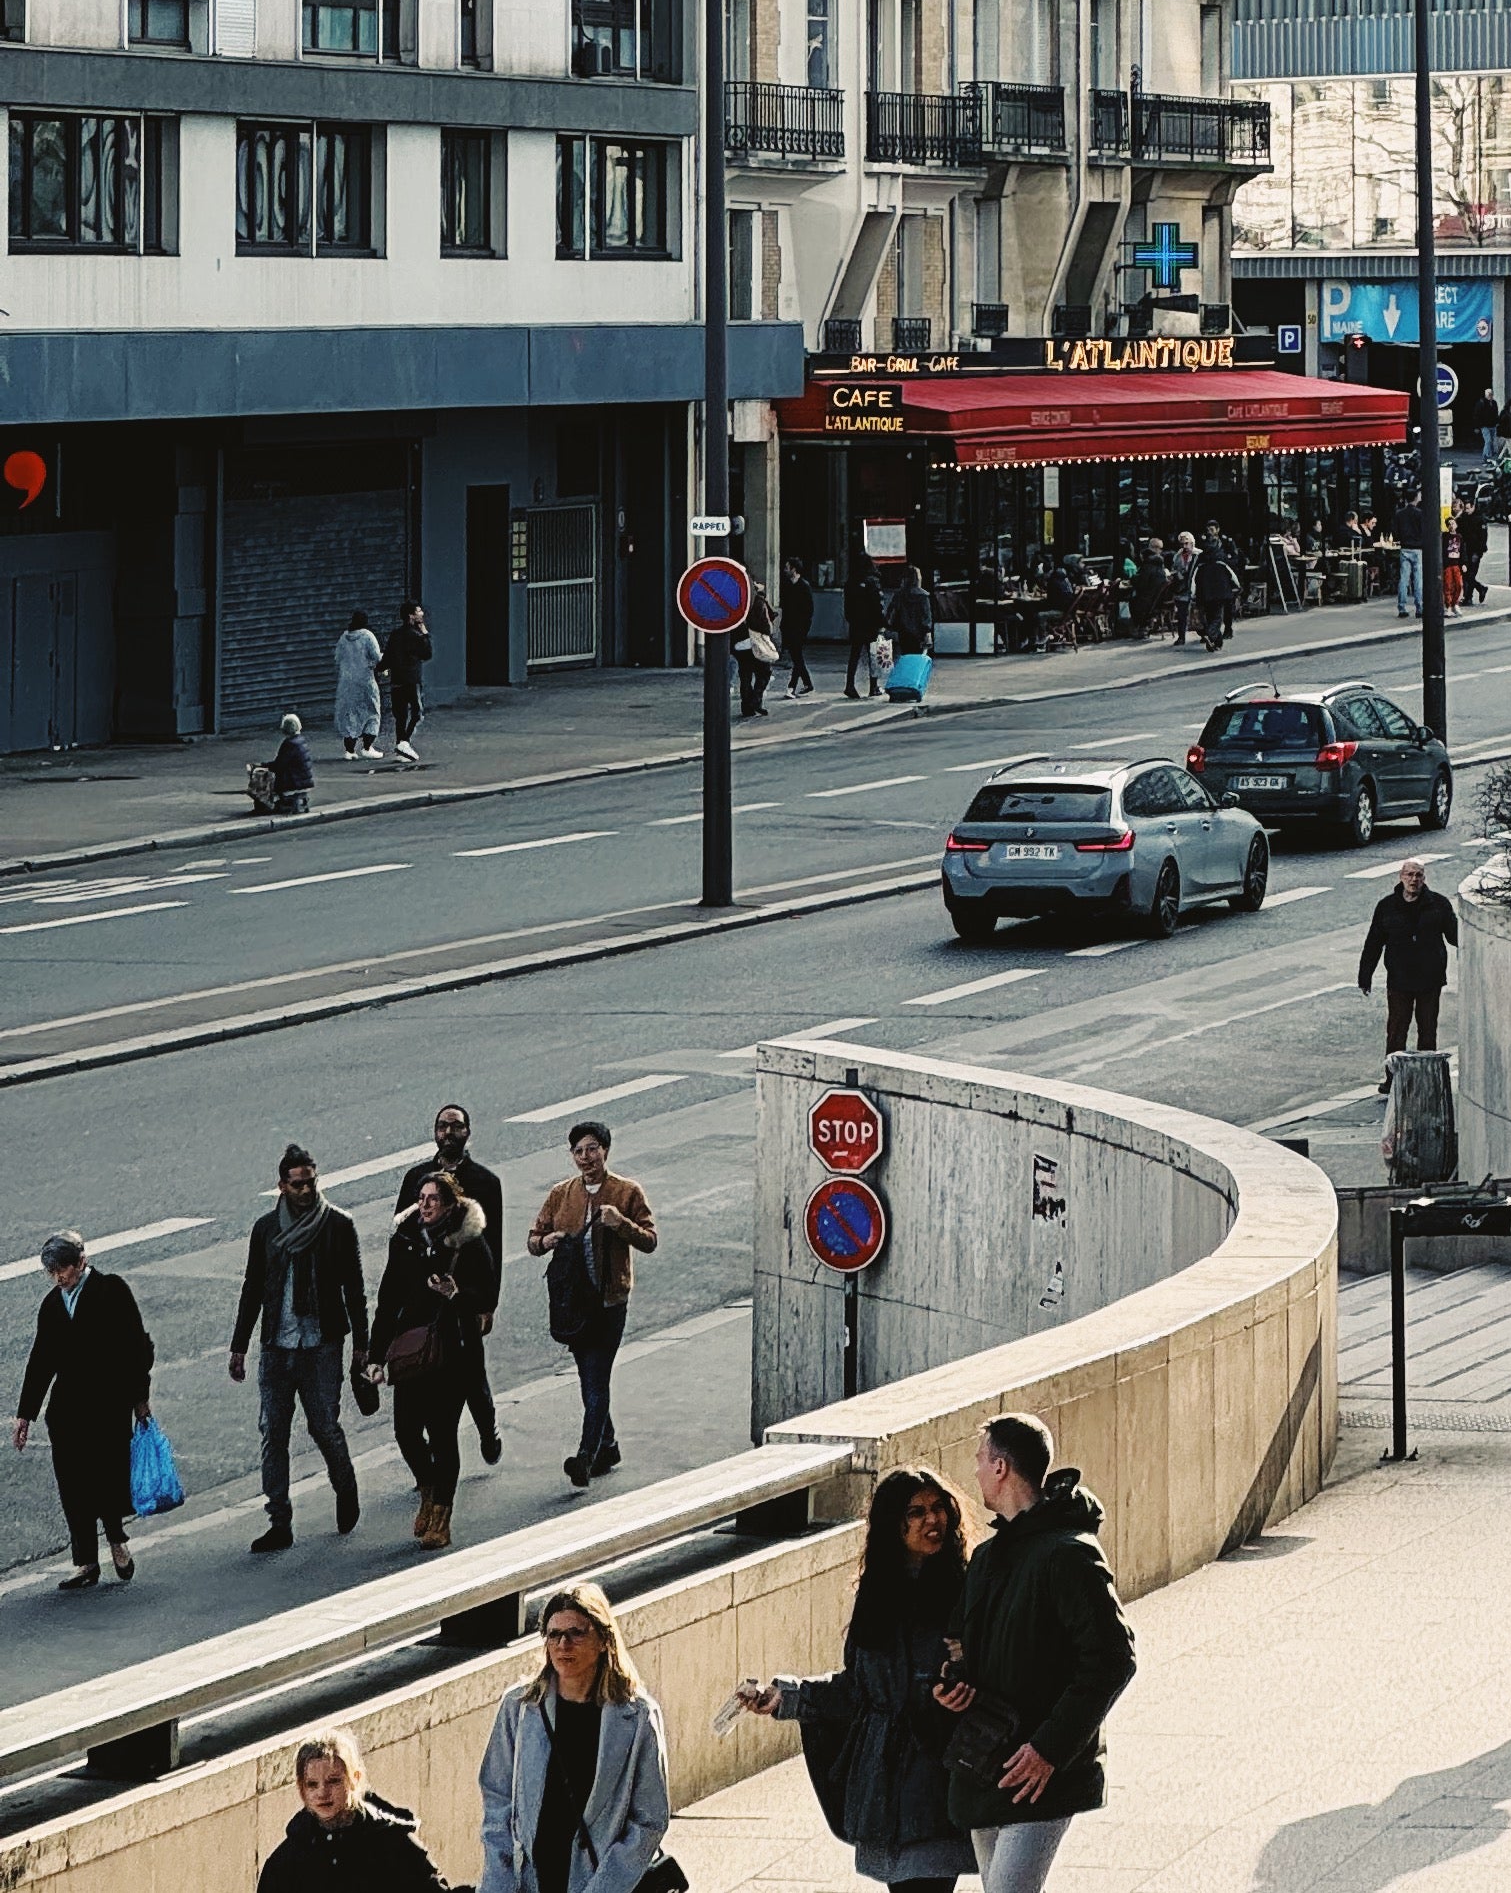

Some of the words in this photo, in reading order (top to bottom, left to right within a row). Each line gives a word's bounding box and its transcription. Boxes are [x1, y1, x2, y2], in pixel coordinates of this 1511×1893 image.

[1307, 314, 1317, 325] 50
[1332, 320, 1364, 335] MAINE
[1045, 337, 1235, 373] L'ATLANTIQUE
[832, 387, 894, 408] CAFE
[825, 415, 904, 433] L'ATLANTIQUE
[692, 522, 727, 532] RAPPEL
[817, 1119, 874, 1145] STOP
